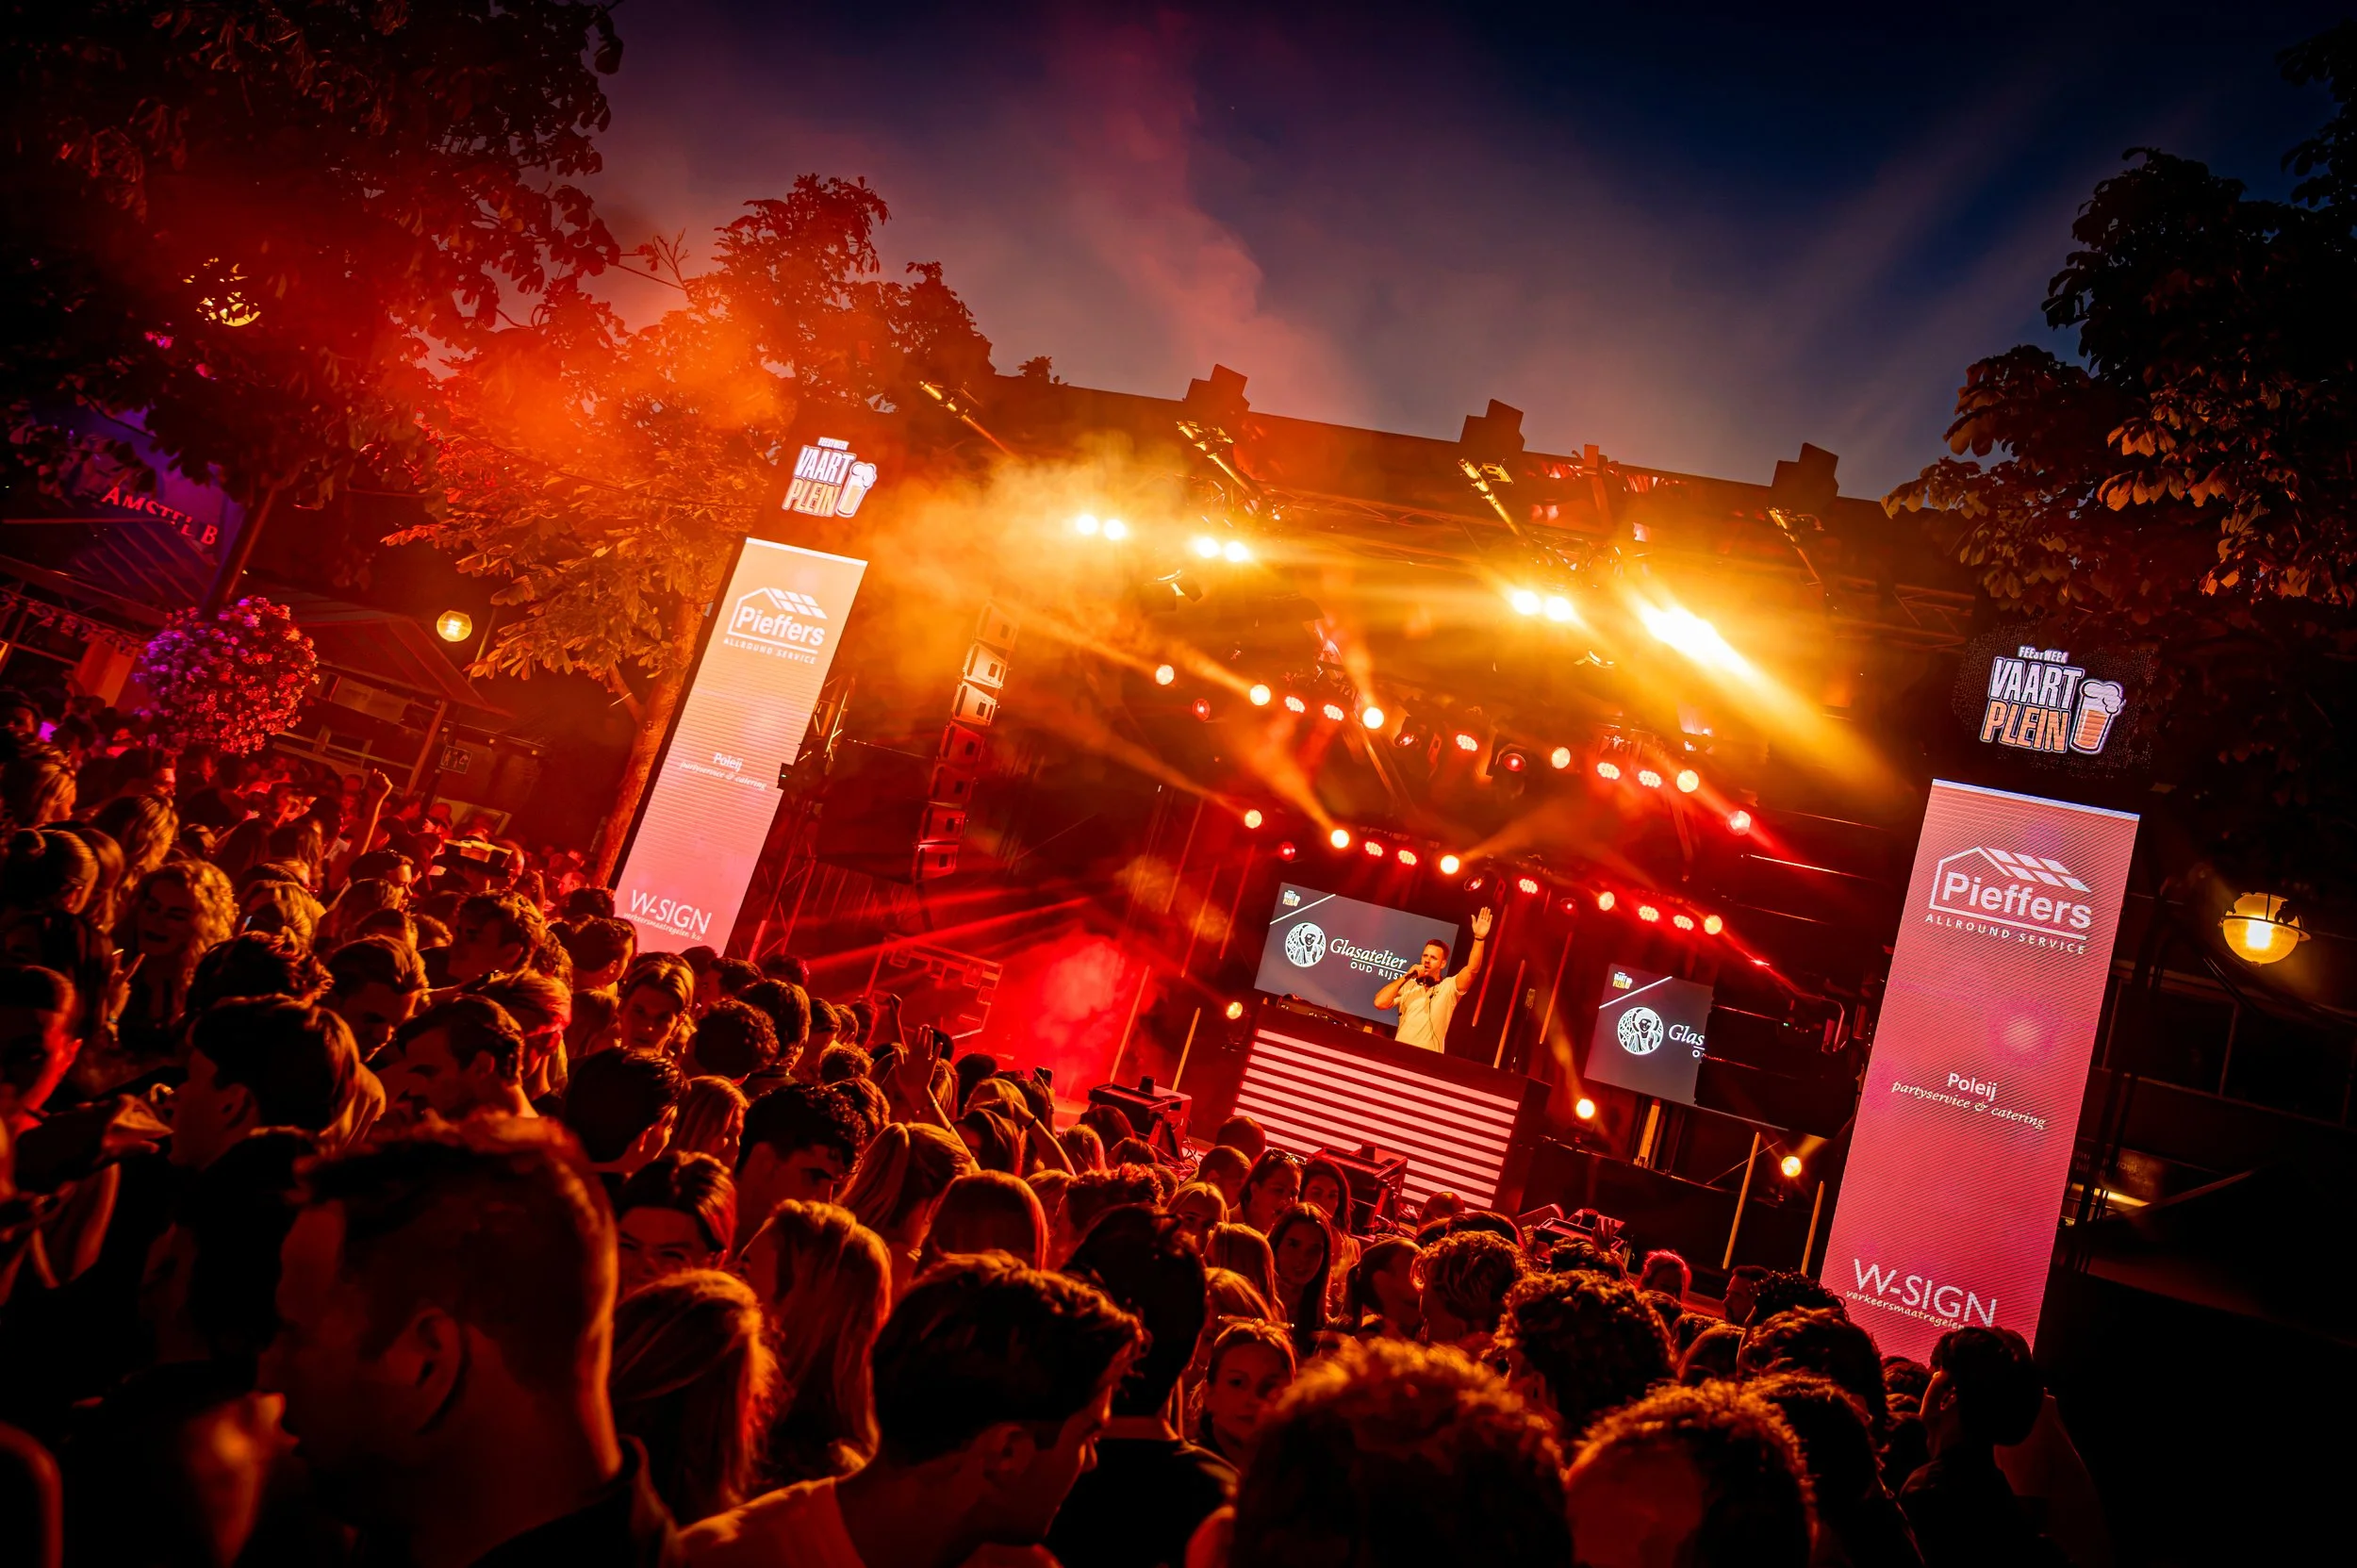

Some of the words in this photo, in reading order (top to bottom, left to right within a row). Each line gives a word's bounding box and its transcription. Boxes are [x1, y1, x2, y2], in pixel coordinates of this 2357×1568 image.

[794, 445, 856, 485] VAART
[782, 478, 842, 518] PLEIN
[736, 605, 826, 646] Pieffers
[723, 637, 773, 655] ALLROUND
[776, 649, 816, 665] SERVICE
[1987, 656, 2085, 710] VAART
[1981, 700, 2071, 753] PLEIN
[712, 751, 744, 773] Poleij
[631, 889, 712, 934] W-SIGN
[1941, 871, 2093, 930] Pieffers
[1330, 938, 1408, 969] Glasatelier
[1925, 913, 2010, 938] ALLROUND
[2019, 933, 2086, 955] SERVICE
[1350, 962, 1373, 973] OUD
[1668, 1024, 1706, 1046] Glas
[1891, 1081, 1971, 1109] partyservice
[1974, 1100, 1989, 1112] &
[1991, 1105, 2047, 1131] catering
[1948, 1072, 1998, 1101] Poleij
[1854, 1258, 1998, 1328] W-SIGN
